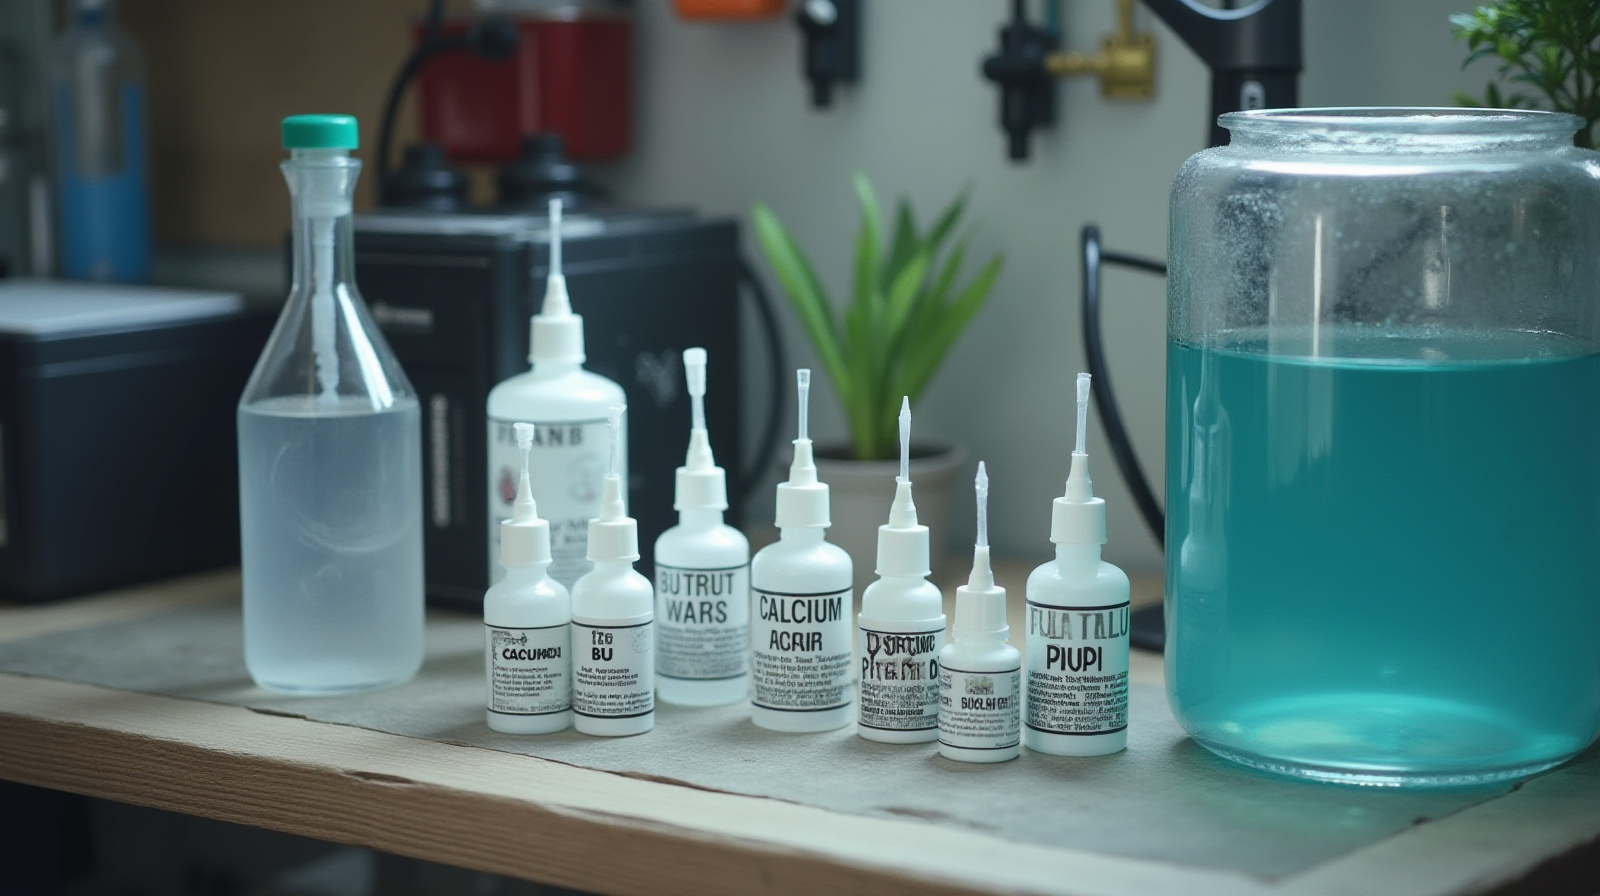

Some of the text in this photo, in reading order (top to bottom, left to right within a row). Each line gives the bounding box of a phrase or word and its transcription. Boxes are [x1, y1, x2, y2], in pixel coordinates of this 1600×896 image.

[661, 571, 735, 597] BUTRUT
[666, 599, 728, 624] WARS
[759, 595, 842, 624] CALCIUM
[592, 647, 613, 661] BU
